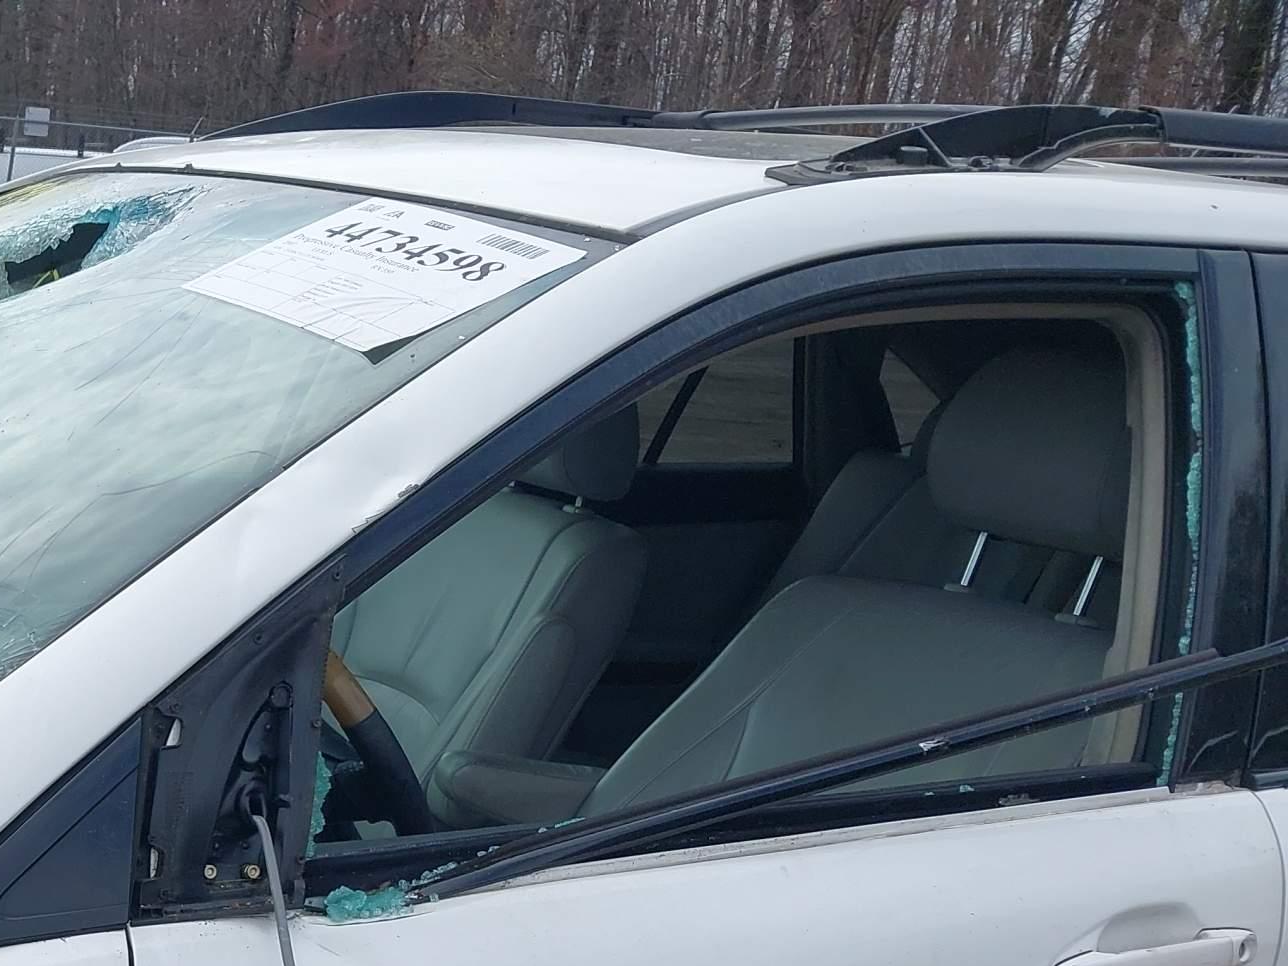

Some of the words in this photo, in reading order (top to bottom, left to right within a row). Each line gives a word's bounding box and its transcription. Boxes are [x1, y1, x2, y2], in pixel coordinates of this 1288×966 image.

[294, 233, 338, 250] Progressive
[339, 244, 378, 260] Casualty
[376, 255, 420, 273] Insurance
[324, 221, 507, 282] 44734598
